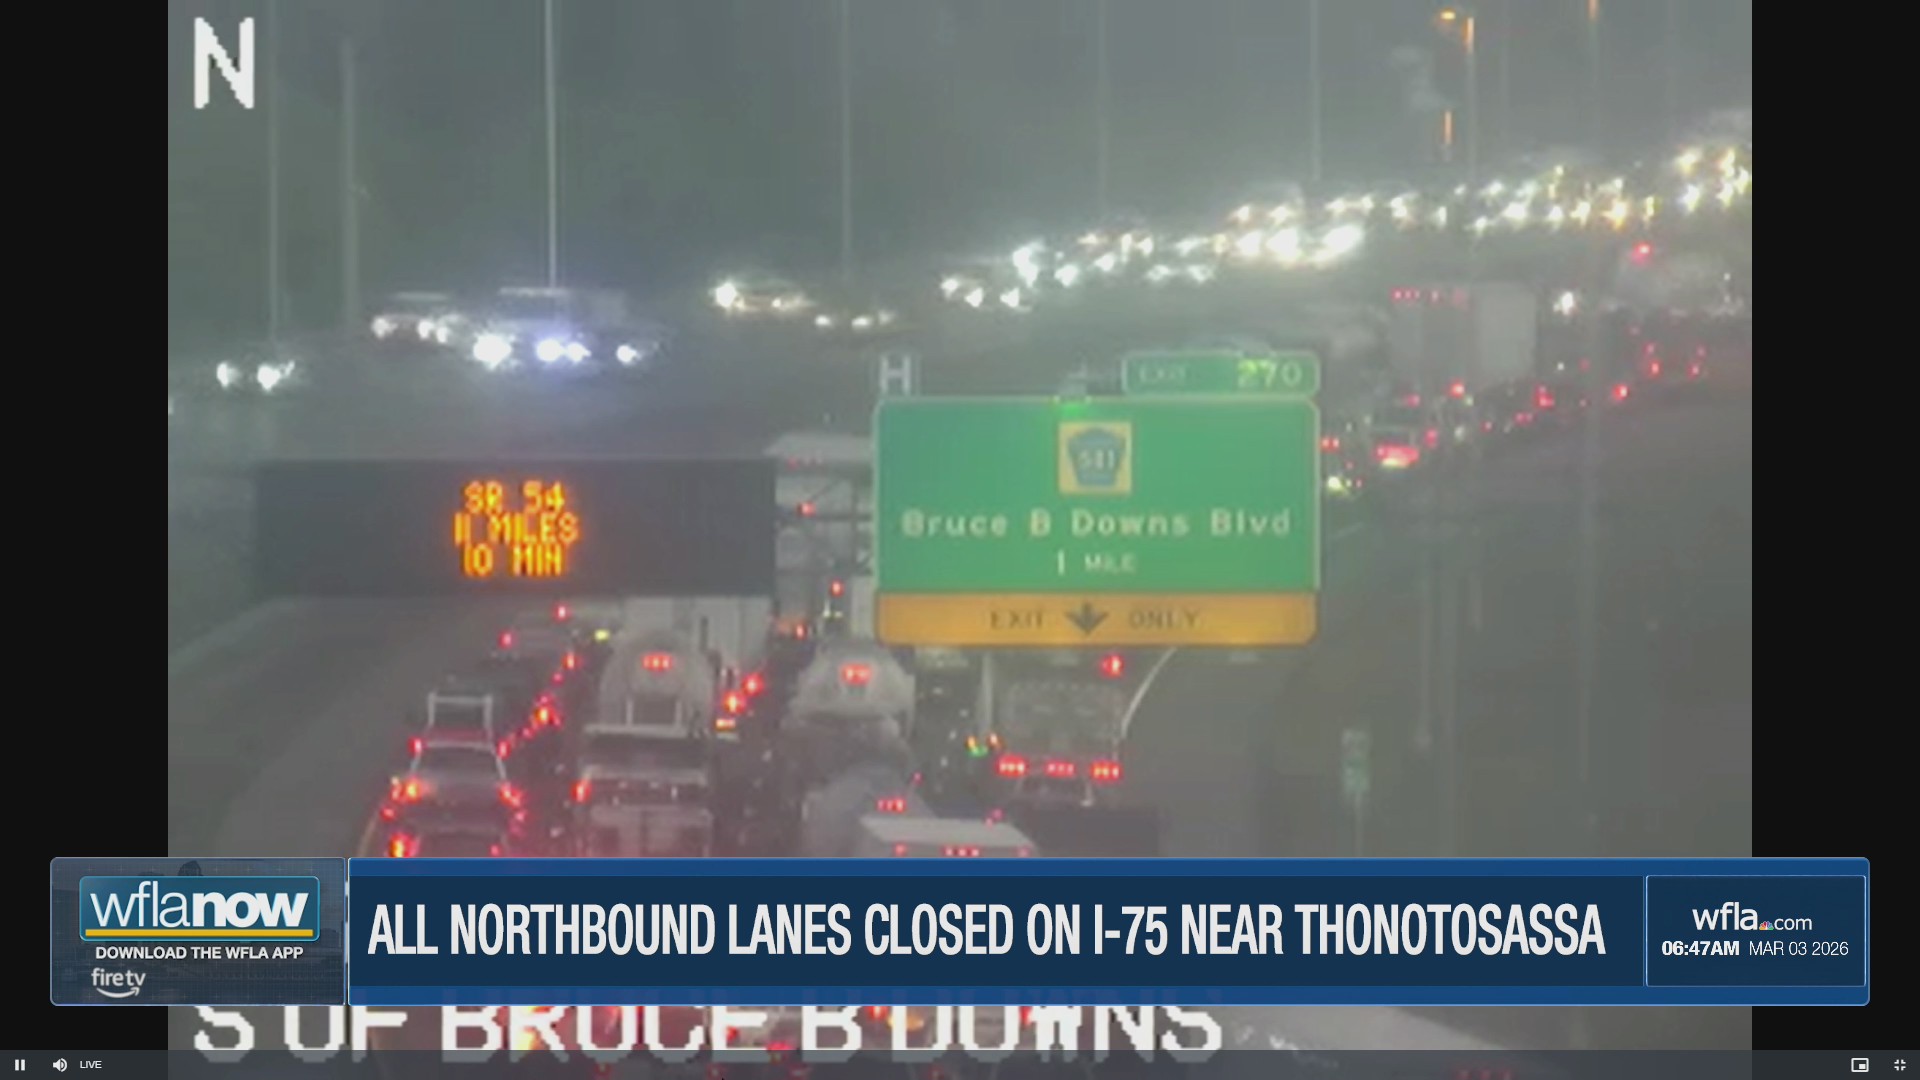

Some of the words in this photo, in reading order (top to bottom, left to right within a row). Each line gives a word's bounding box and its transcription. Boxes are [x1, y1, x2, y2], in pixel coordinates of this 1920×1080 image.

[1237, 359, 1302, 388] 270
[464, 480, 503, 514] SR
[523, 480, 565, 514] 54
[488, 511, 579, 544] MILES
[902, 510, 1007, 537] Bruce
[1030, 509, 1051, 537] B
[1072, 510, 1189, 537] Downs
[1210, 509, 1292, 537] Blvd
[464, 543, 493, 576] 10
[513, 545, 562, 576] MIN
[1057, 551, 1066, 576] 1
[1085, 554, 1137, 573] MILE
[990, 610, 1044, 631] EXIT
[1128, 608, 1201, 631] ONLY
